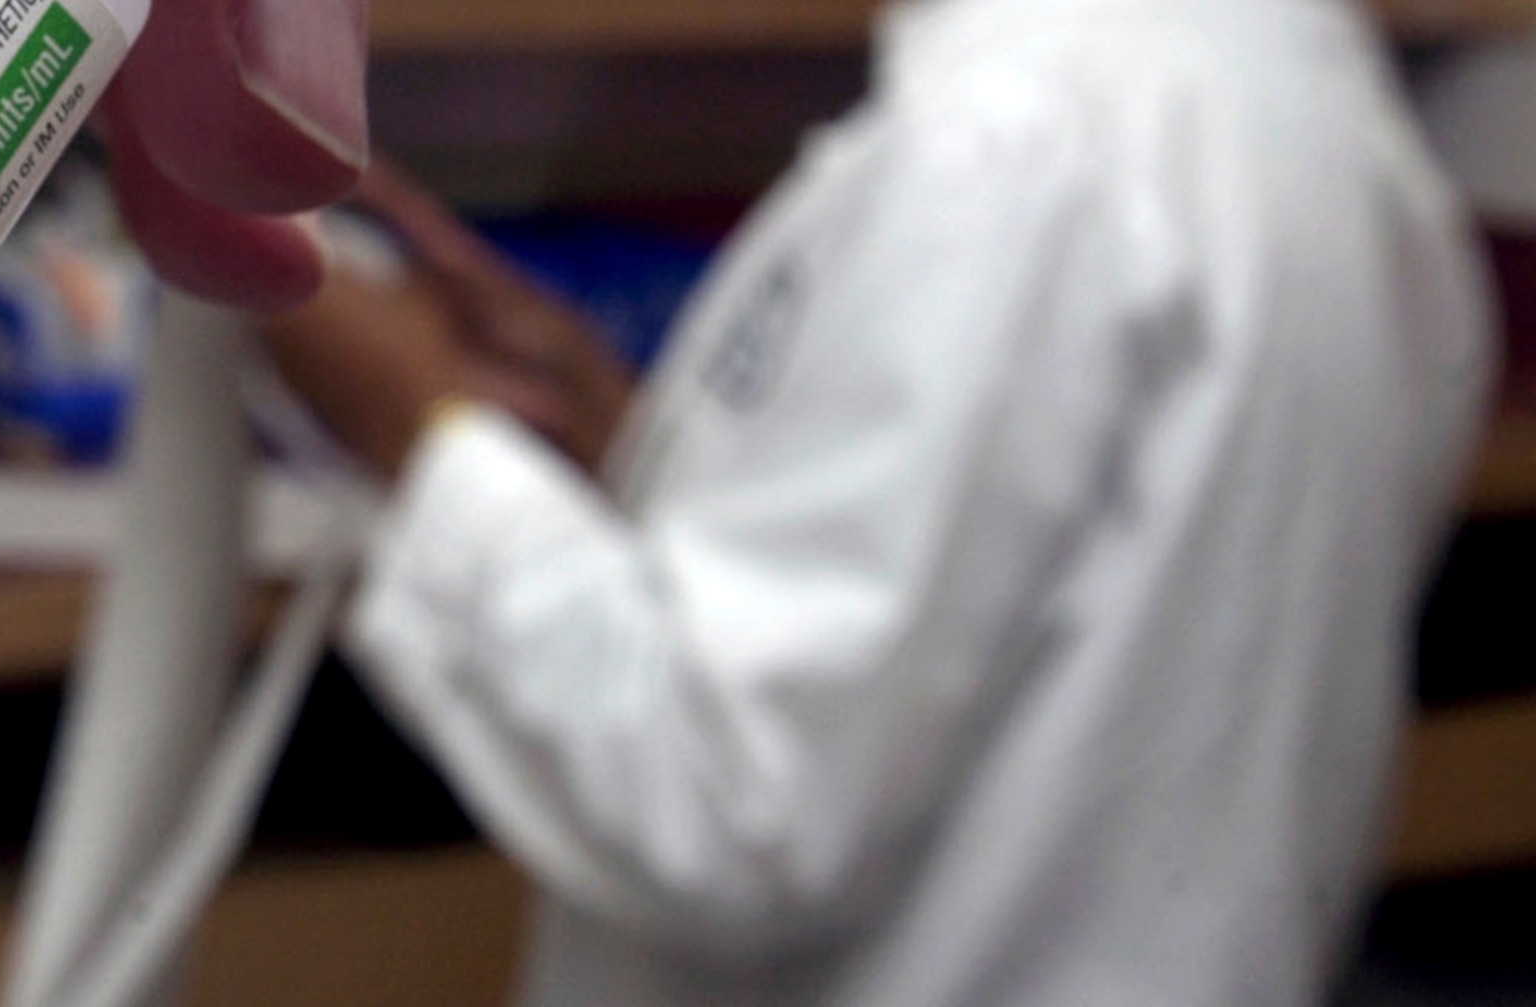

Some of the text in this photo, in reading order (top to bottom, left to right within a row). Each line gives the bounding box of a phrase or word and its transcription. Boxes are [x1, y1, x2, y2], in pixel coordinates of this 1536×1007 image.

[19, 152, 36, 179] or
[33, 122, 57, 154] IM
[54, 83, 85, 124] Use
